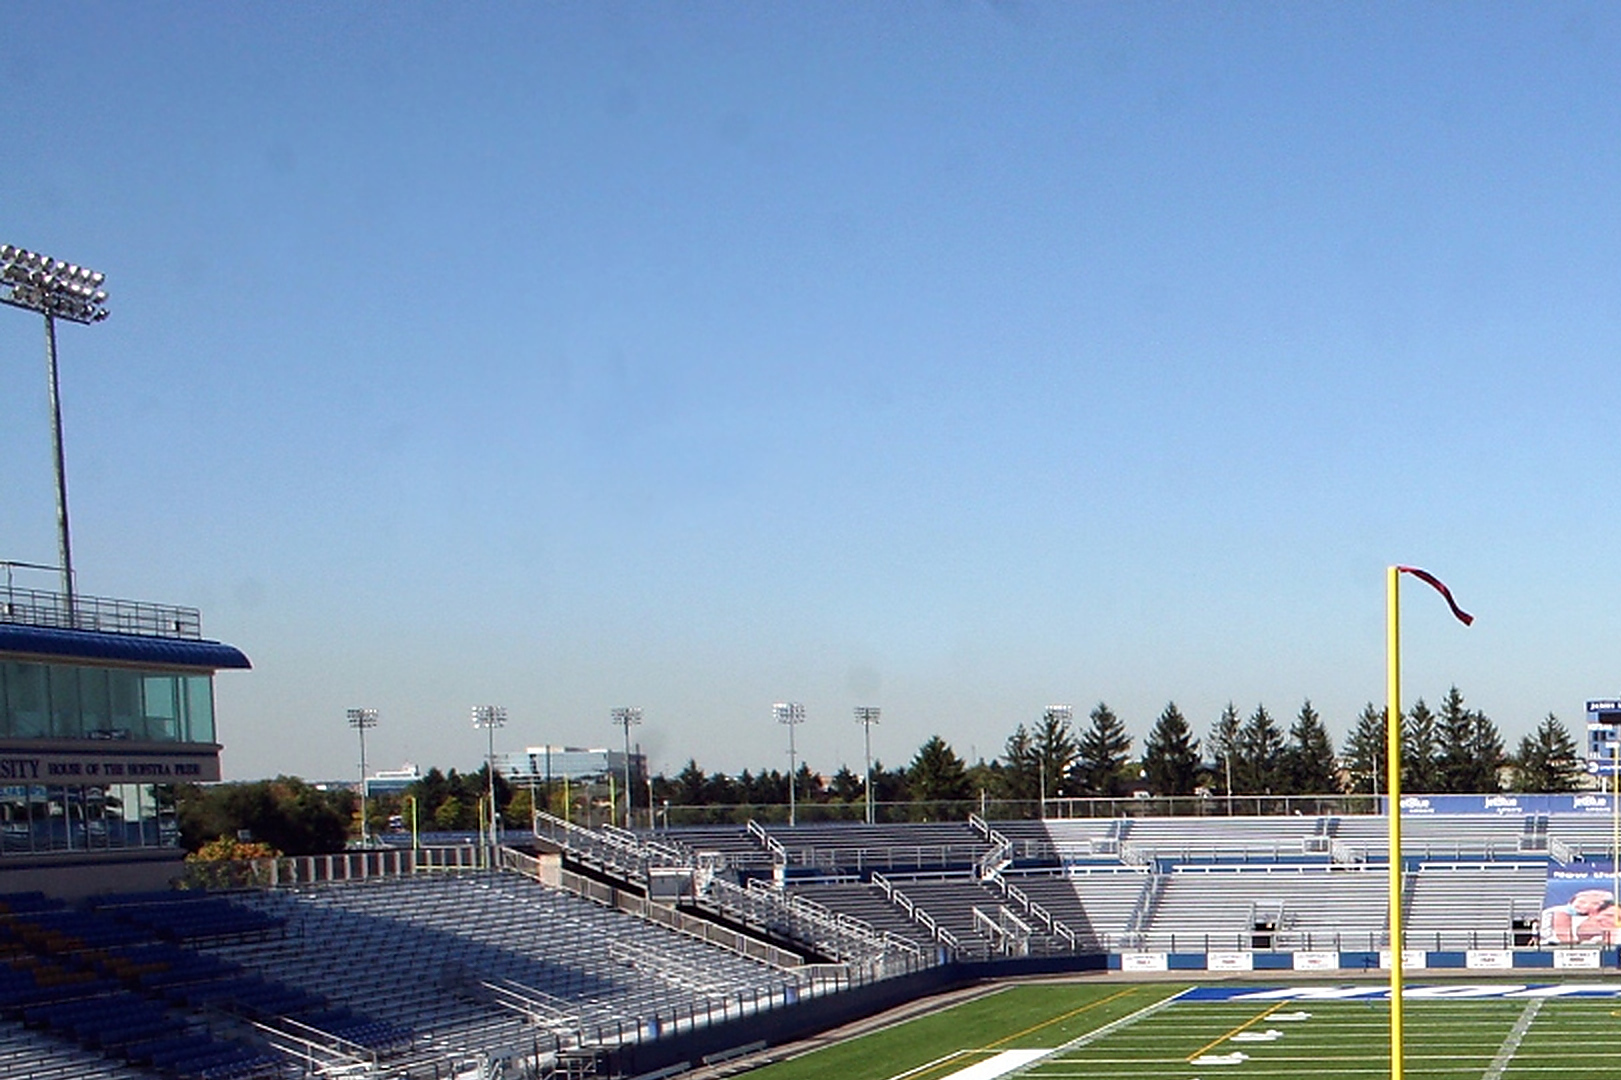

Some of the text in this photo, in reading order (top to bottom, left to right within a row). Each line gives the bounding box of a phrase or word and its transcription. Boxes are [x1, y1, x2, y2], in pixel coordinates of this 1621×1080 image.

[48, 763, 82, 775] HOUSE
[86, 763, 100, 775] OF
[104, 763, 123, 775] THE
[128, 763, 170, 775] HOFSTRA
